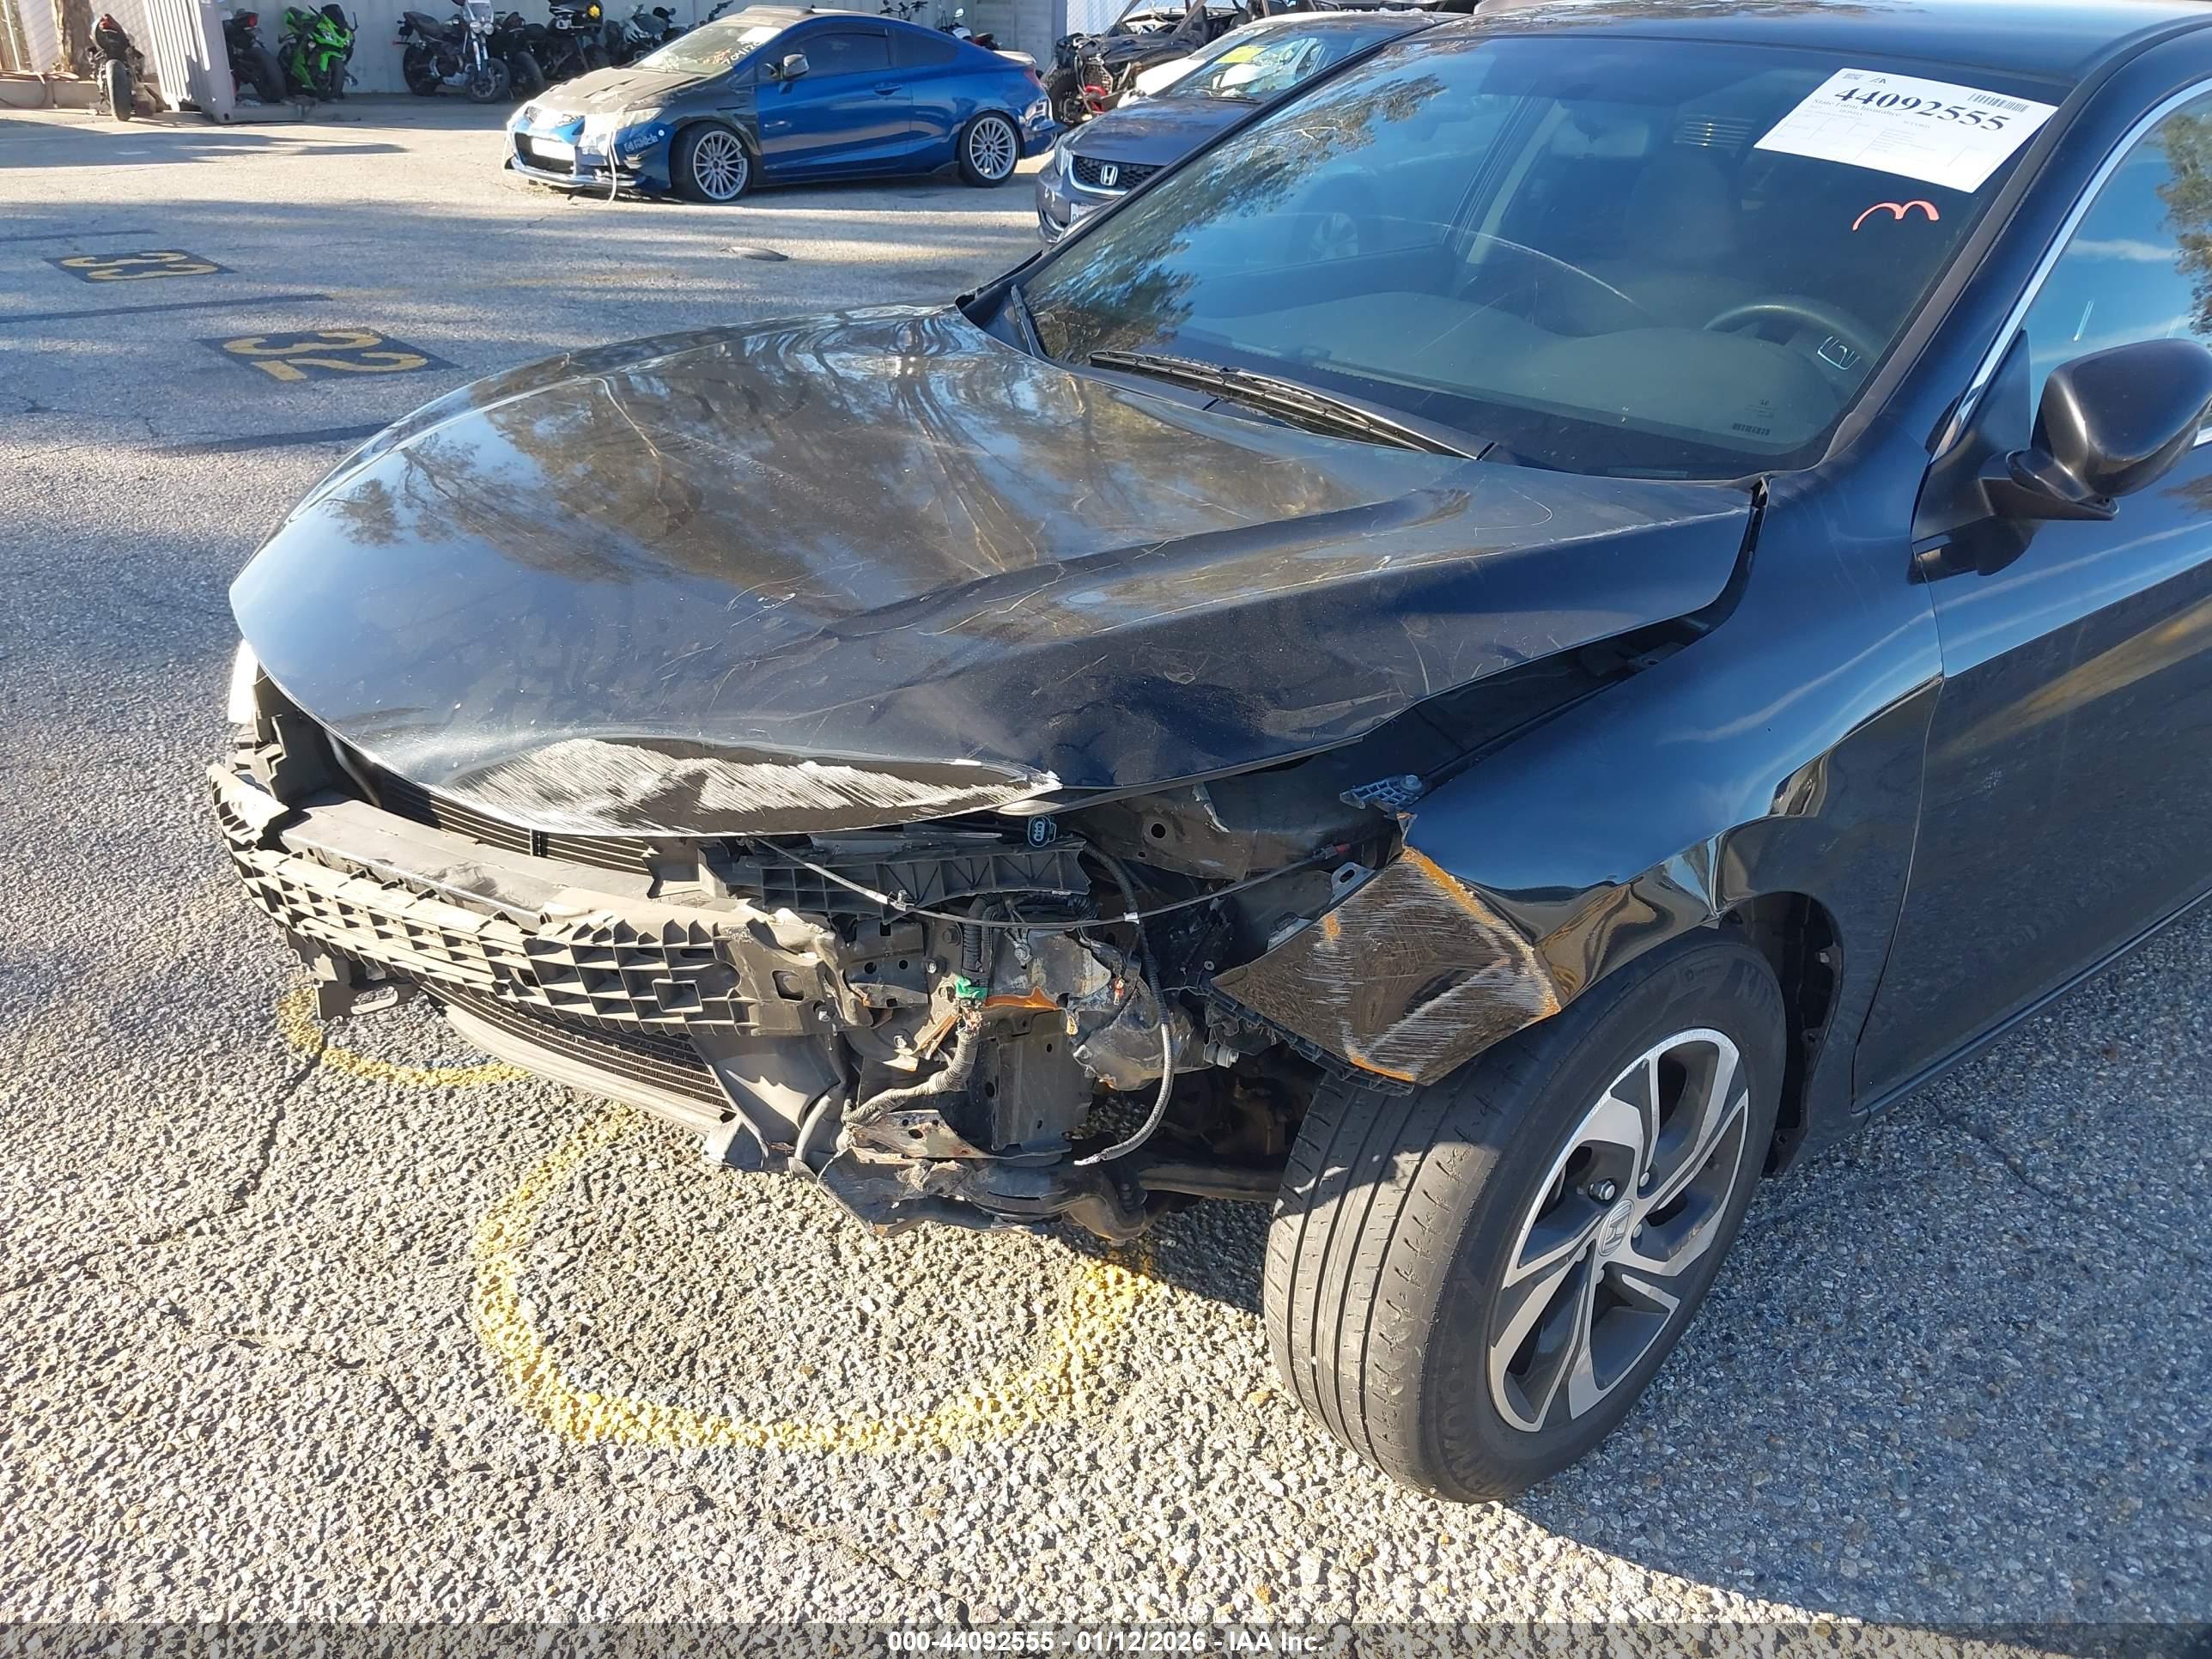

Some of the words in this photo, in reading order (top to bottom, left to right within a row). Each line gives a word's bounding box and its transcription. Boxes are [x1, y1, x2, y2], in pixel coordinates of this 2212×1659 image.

[1834, 88, 2011, 131] 44092555
[1862, 105, 1902, 118] Insurance
[61, 252, 219, 280] 33
[223, 332, 428, 381] 32
